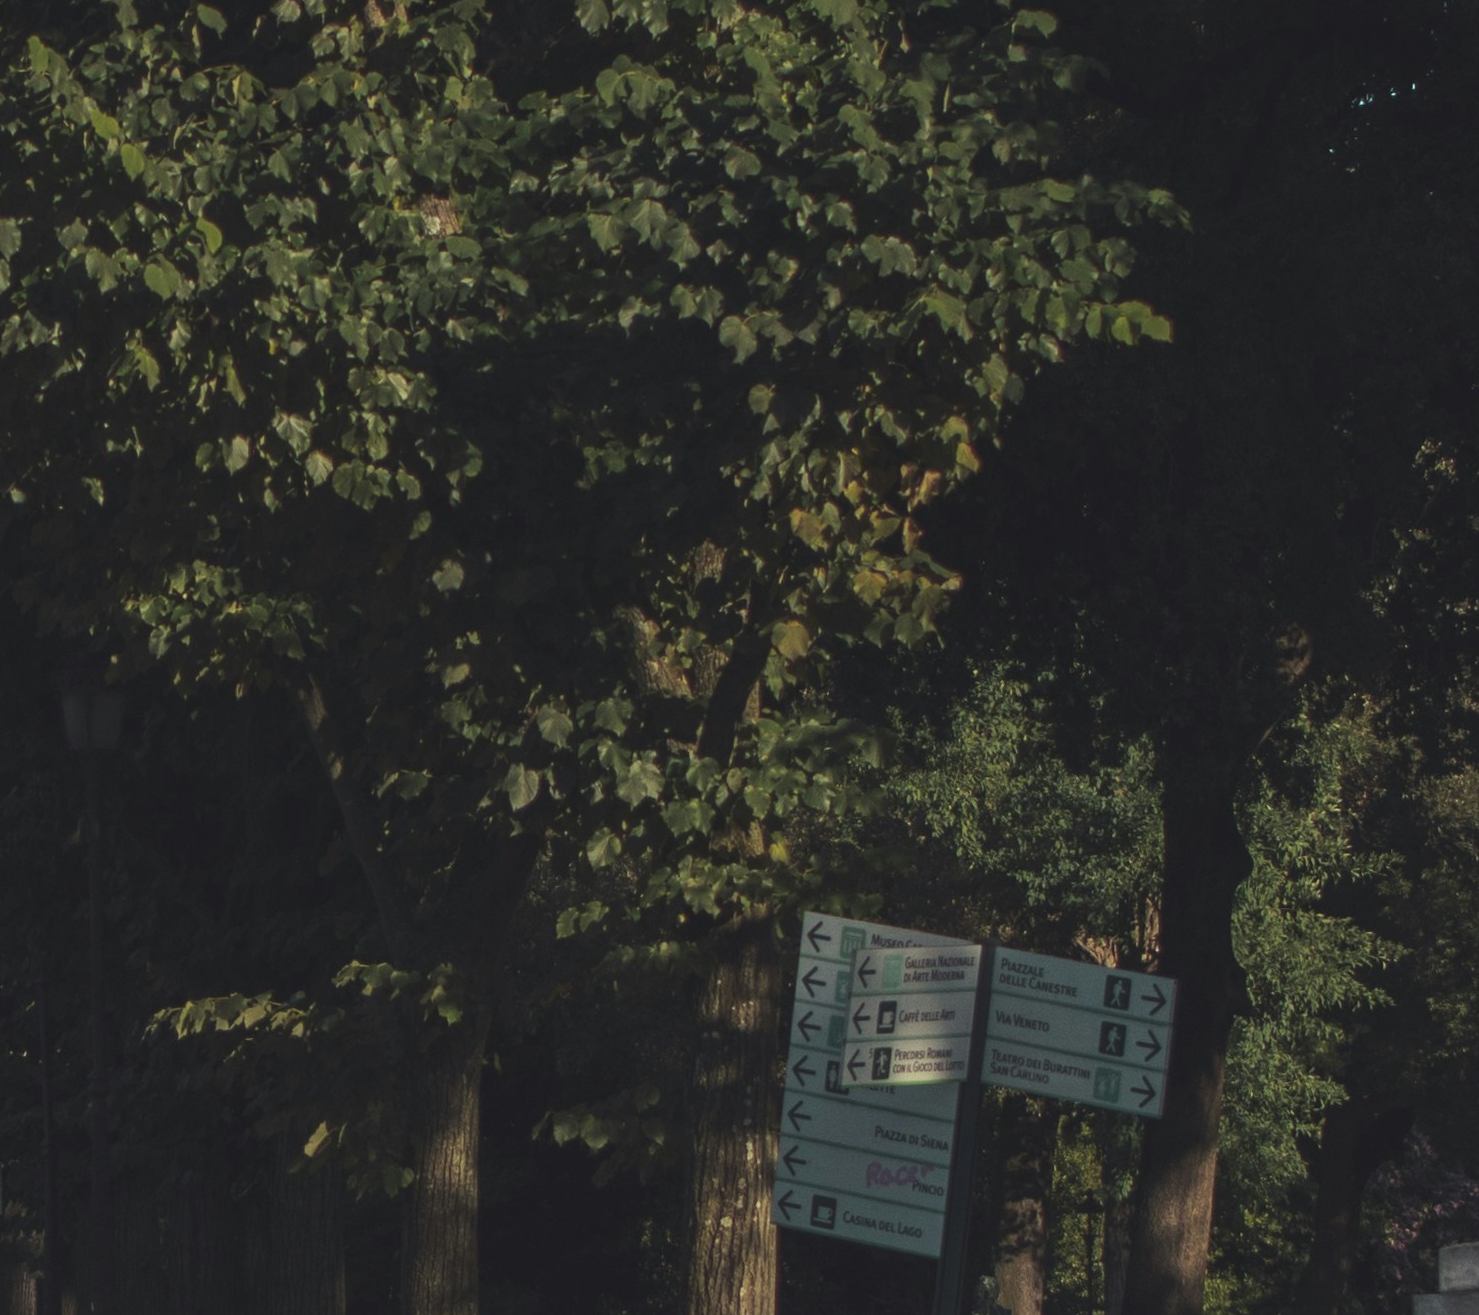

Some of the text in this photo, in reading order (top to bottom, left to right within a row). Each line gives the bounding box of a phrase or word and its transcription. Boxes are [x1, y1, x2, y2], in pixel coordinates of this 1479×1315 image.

[904, 955, 976, 969] GALLERIA NAZIONALE
[1000, 957, 1044, 978] PIAZZALE
[903, 969, 965, 983] DI ARTE MODERNA
[998, 973, 1078, 997] DELLE CANESTRE
[920, 1011, 939, 1022] DELLE
[940, 1008, 956, 1021] ARTI
[995, 1009, 1050, 1033] VIA VENETO
[894, 1047, 953, 1061] PERCORSI ROMANI
[991, 1048, 1091, 1079] TEATRO DEI BURATTINI
[892, 1060, 964, 1074] CON IL GIOCO DEL LOTTO
[989, 1061, 1050, 1084] SAN CARLINO
[874, 1125, 949, 1152] PIAZZA DI SIENA
[912, 1179, 944, 1197] PINCIO
[842, 1210, 923, 1238] CASINA DEL LAGO
